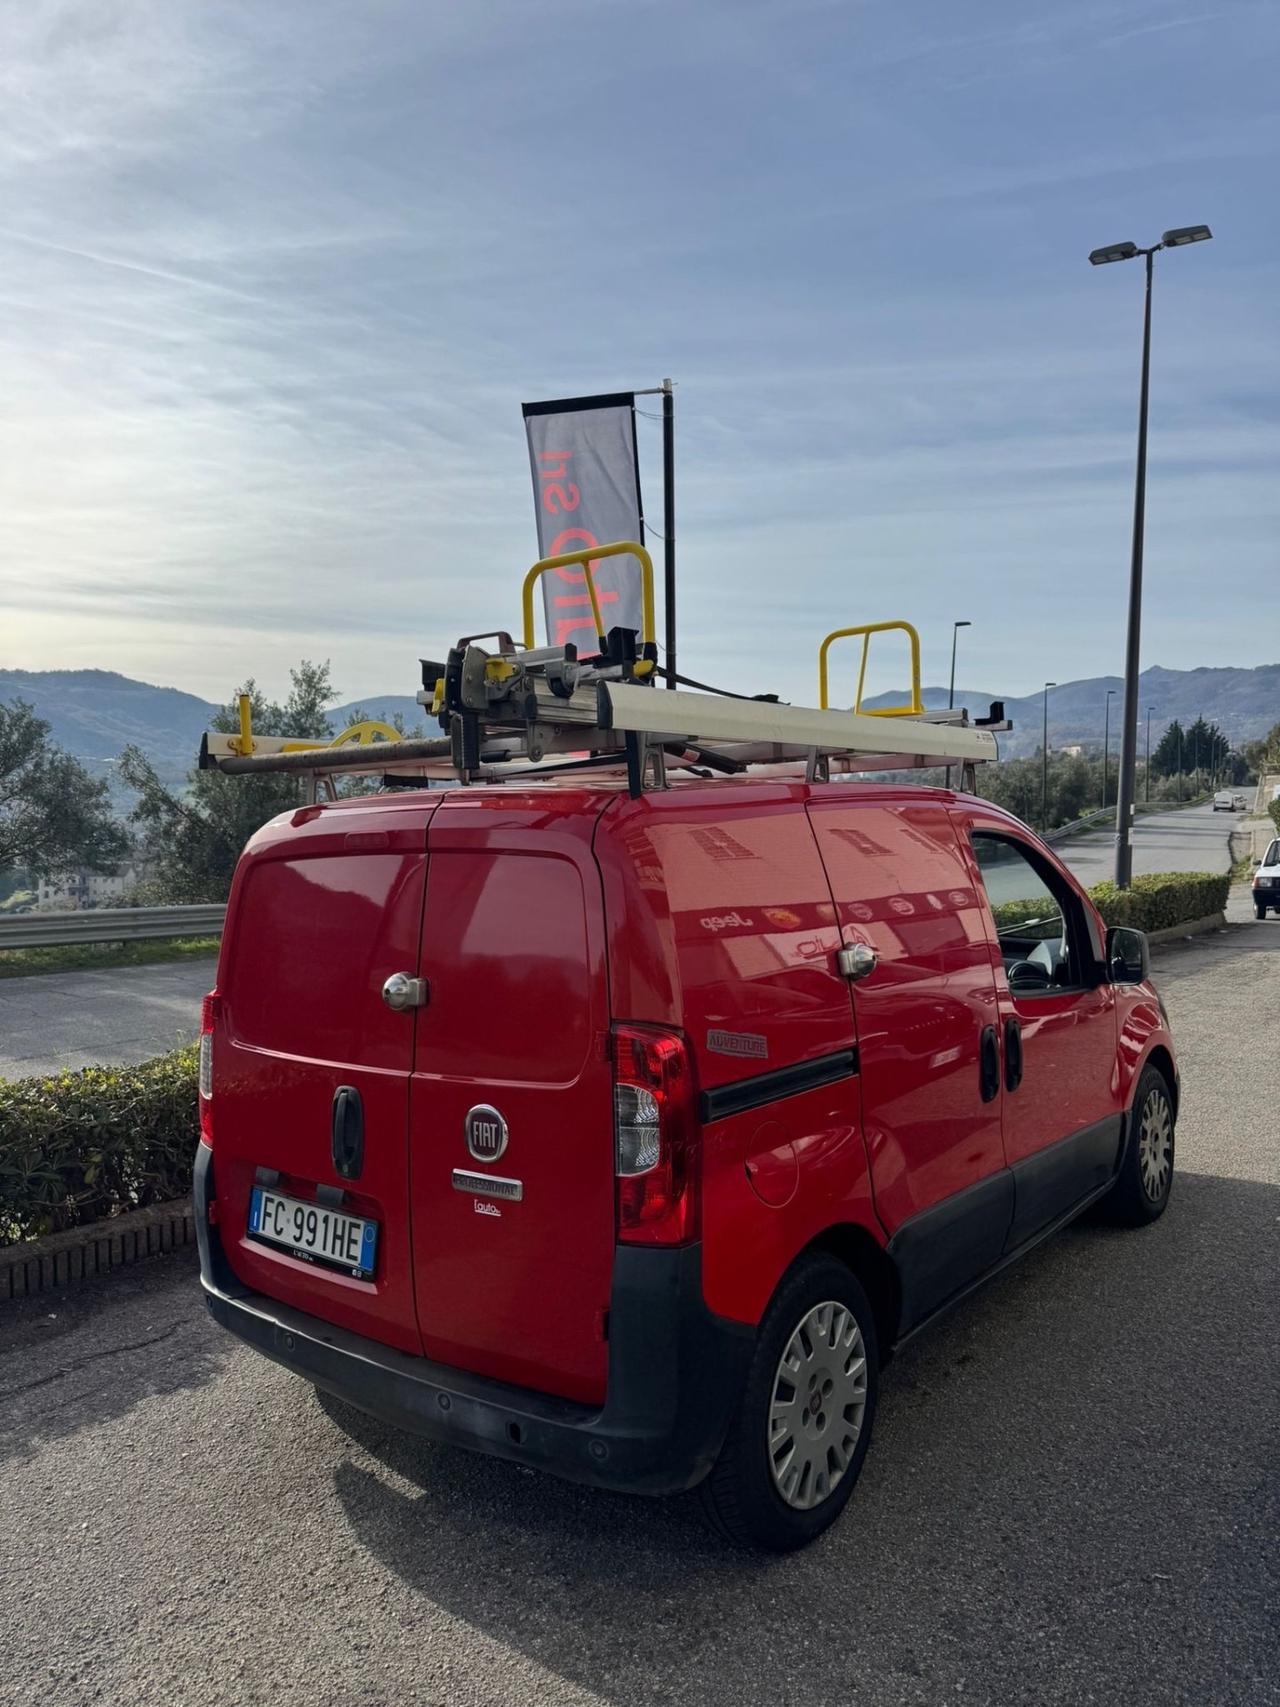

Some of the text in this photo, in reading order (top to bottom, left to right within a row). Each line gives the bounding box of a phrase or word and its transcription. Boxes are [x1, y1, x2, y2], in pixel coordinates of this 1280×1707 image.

[473, 1121, 498, 1148] FIAT
[261, 1195, 362, 1262] FC 991HE
